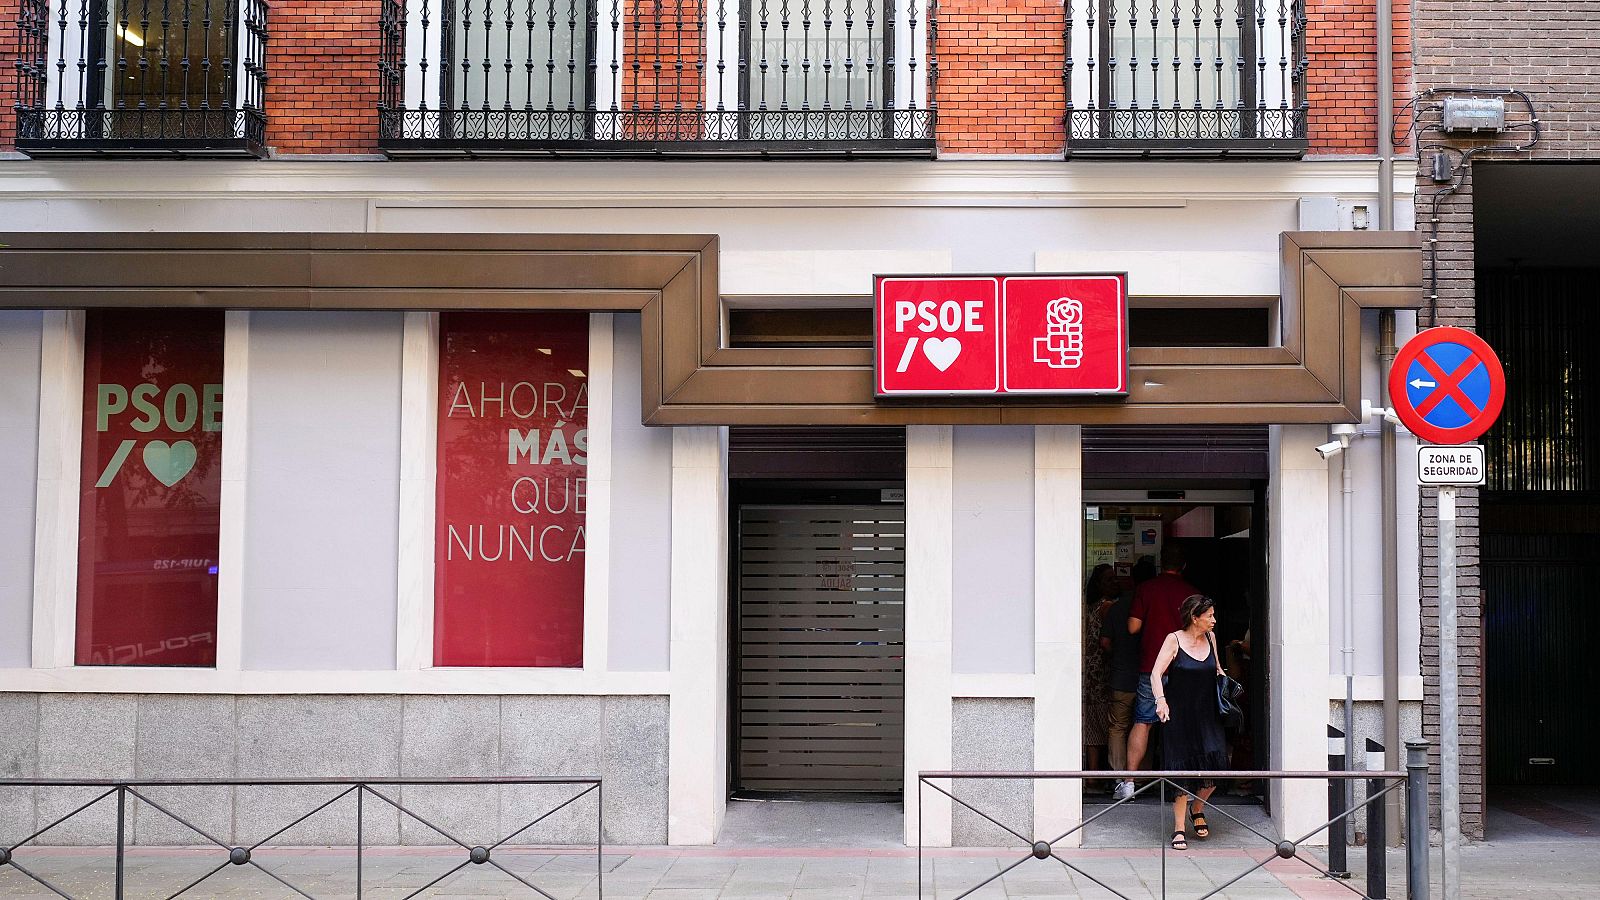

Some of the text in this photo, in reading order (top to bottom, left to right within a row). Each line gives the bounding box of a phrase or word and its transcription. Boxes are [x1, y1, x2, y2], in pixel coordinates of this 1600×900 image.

[895, 300, 984, 333] PSOE
[96, 383, 223, 433] PSOE
[447, 381, 588, 419] AHORA
[507, 419, 588, 466] MÁS
[1429, 454, 1472, 464] ZONA DE
[1423, 466, 1479, 476] SEGURIDAD
[511, 476, 587, 514] QUE
[447, 524, 586, 562] NUNCA
